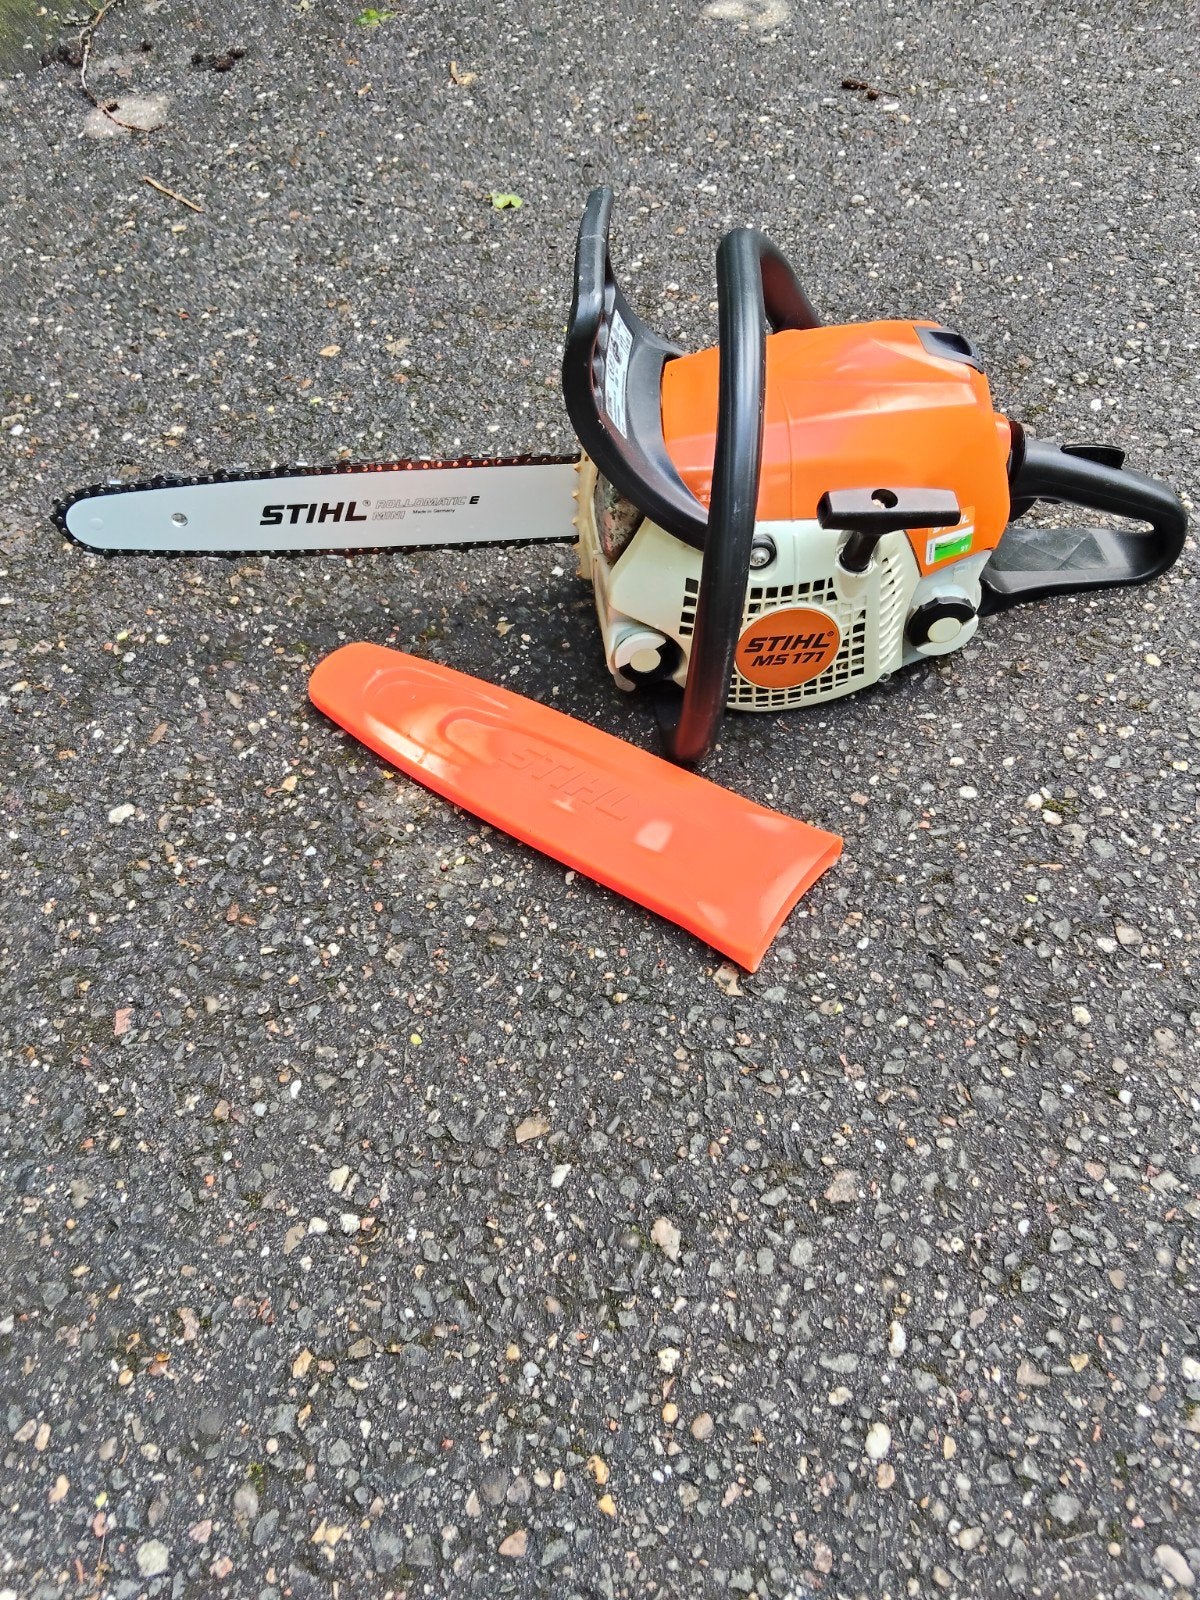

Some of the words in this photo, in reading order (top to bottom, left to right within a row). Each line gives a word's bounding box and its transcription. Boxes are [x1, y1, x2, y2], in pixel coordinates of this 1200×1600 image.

[375, 496, 467, 509] ROLLOMATIC
[469, 495, 480, 505] E
[260, 501, 367, 525] STIHL
[372, 510, 406, 521] MINI
[744, 632, 830, 653] STIHL
[751, 653, 789, 667] MS
[792, 651, 825, 664] 171
